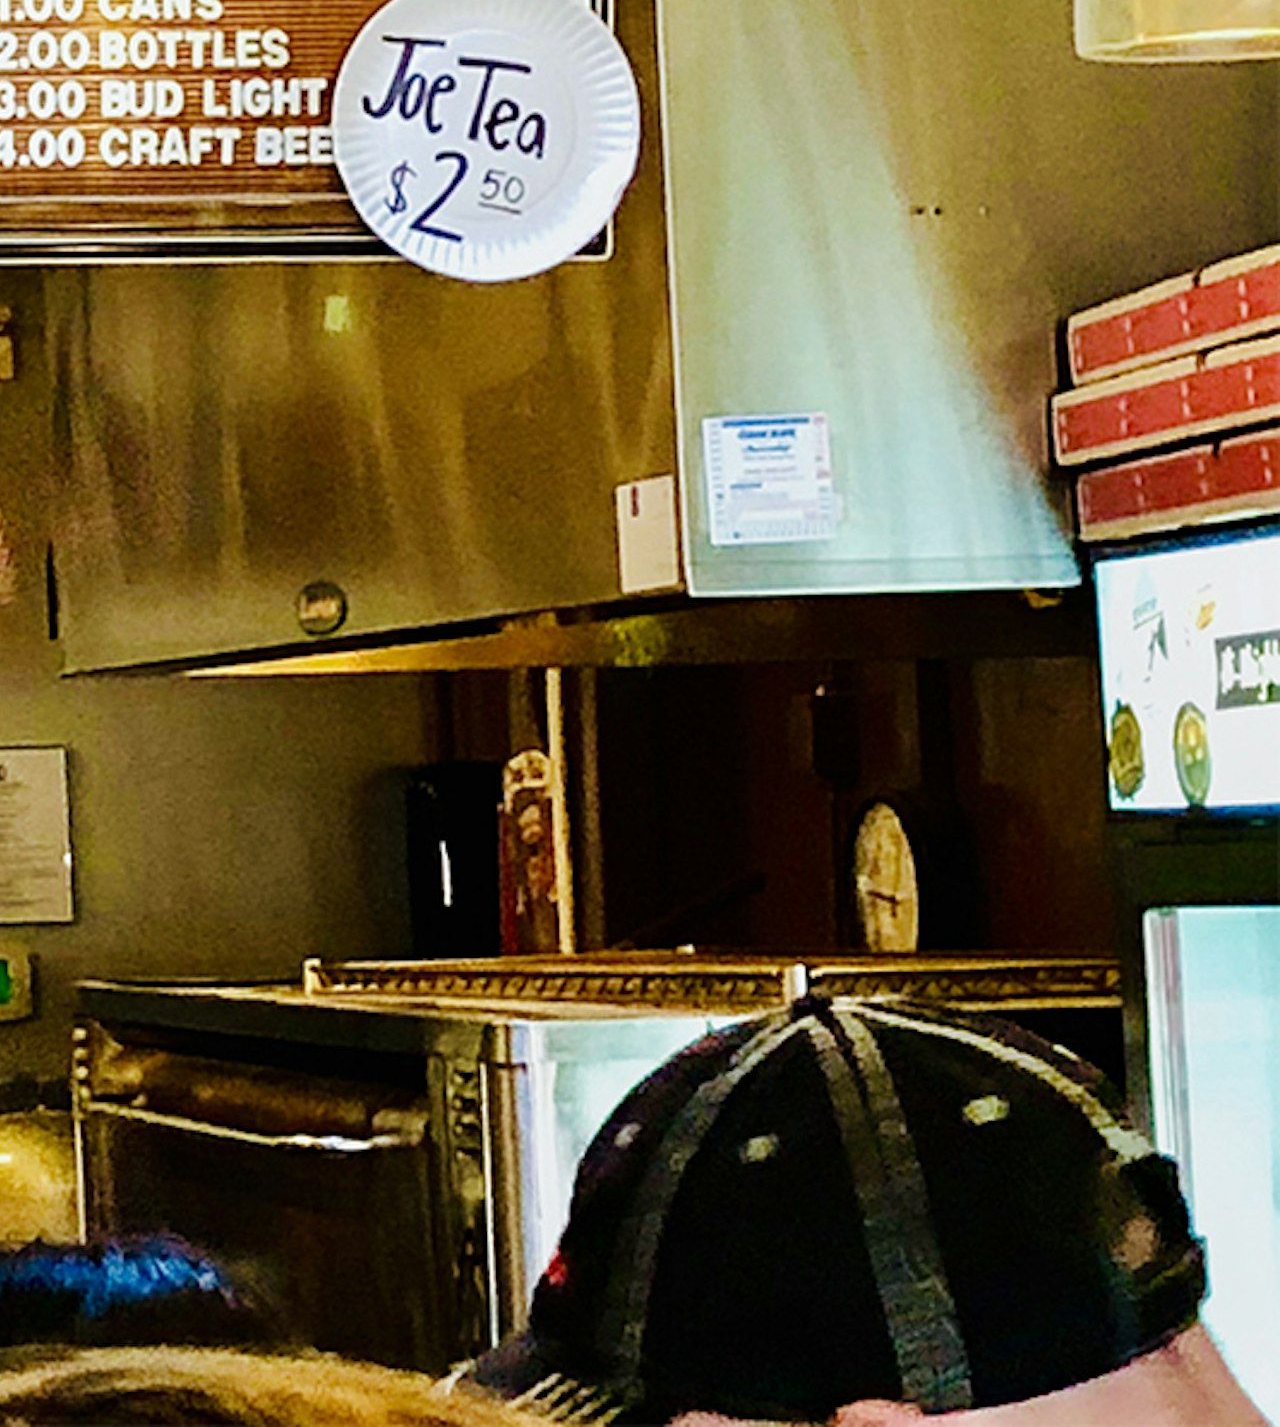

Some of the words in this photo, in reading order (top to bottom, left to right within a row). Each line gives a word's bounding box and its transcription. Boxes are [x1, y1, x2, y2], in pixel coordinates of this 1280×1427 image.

[98, 29, 289, 69] BOTTLES
[101, 80, 184, 118] BUD
[204, 78, 327, 116] LIGHT
[362, 34, 457, 134] Joe
[457, 56, 547, 160] Tea
[99, 127, 241, 166] CRAFT
[254, 127, 333, 166] BEE
